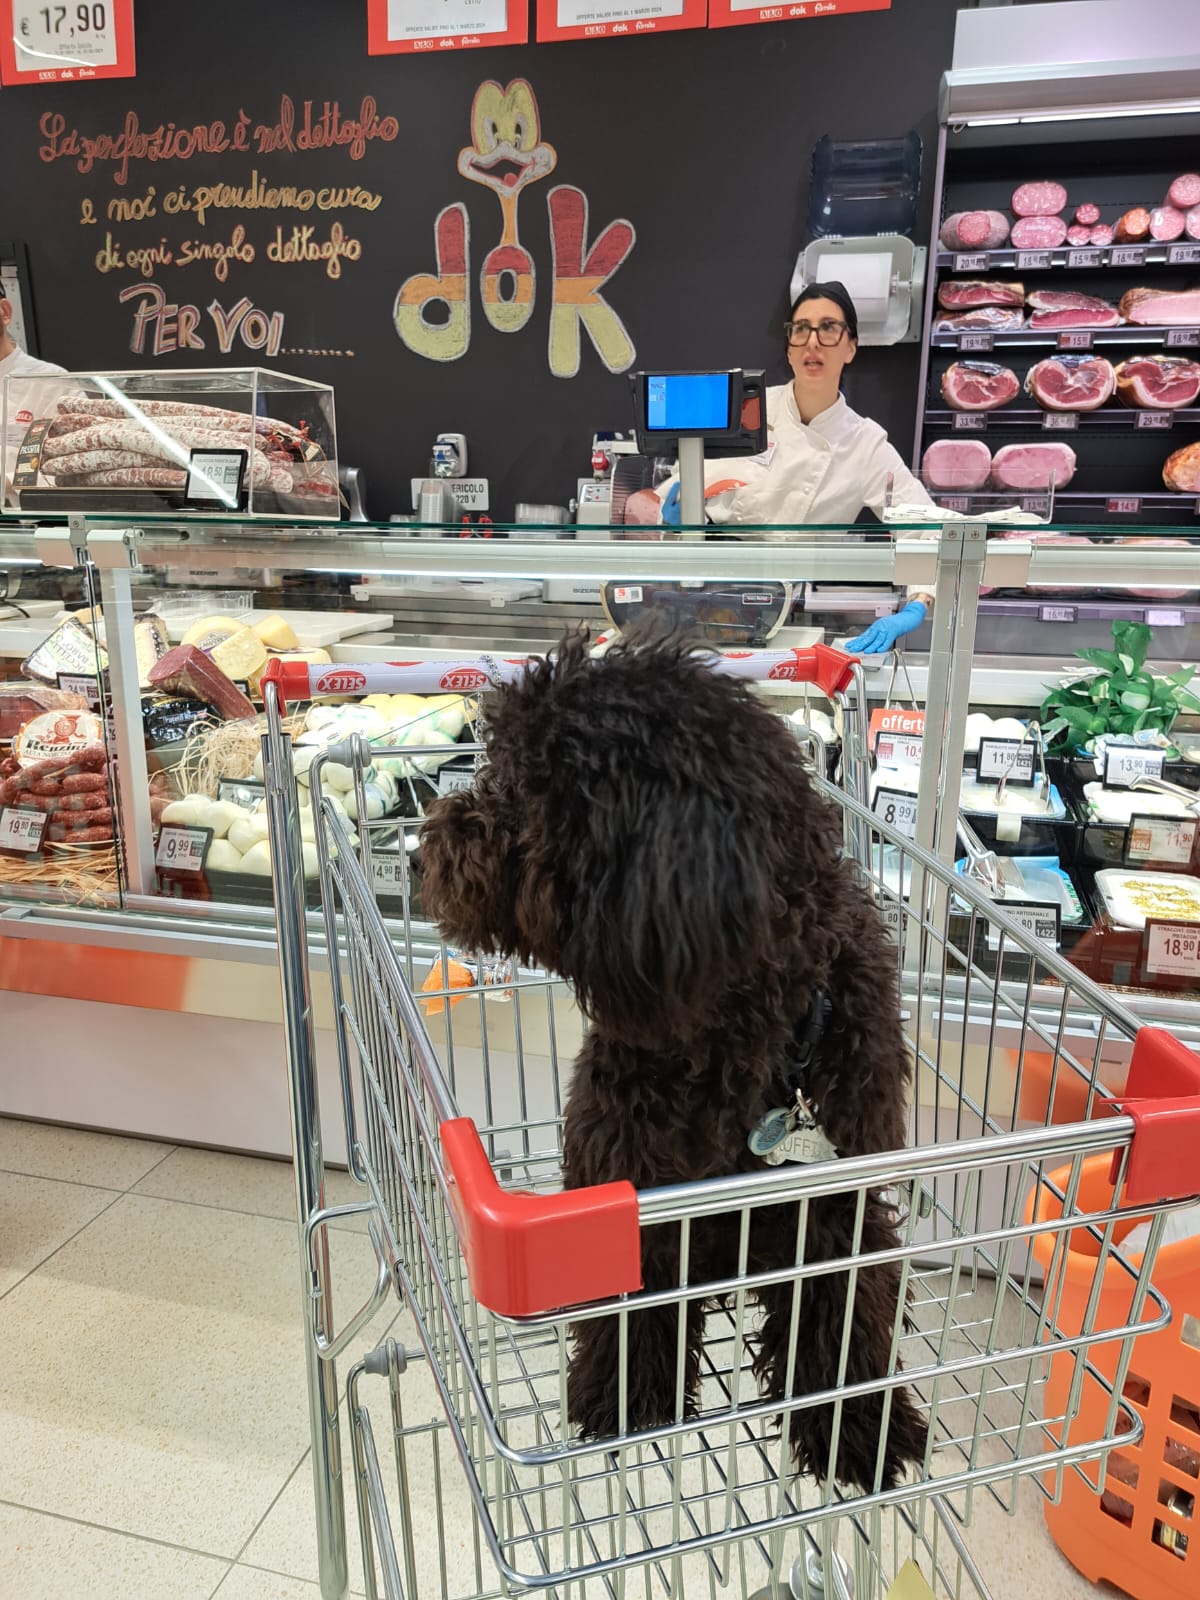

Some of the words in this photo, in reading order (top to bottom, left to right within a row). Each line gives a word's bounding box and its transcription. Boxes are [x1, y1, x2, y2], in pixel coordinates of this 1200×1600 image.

[40, 3, 106, 37] 17,90
[790, 8, 806, 16] dok
[612, 24, 628, 32] dok
[440, 39, 454, 47] dok
[40, 112, 80, 162] La
[230, 108, 252, 150] è
[253, 94, 296, 153] nel
[297, 96, 399, 160] dettaglio
[80, 199, 98, 224] e
[107, 186, 156, 222] noi
[163, 185, 192, 214] ci
[317, 186, 382, 211] cura
[95, 231, 125, 273] di
[126, 238, 173, 277] ogni
[175, 225, 256, 283] singolo
[267, 222, 361, 279] dettaglio
[394, 184, 637, 378] dok
[119, 283, 205, 356] PER
[452, 484, 484, 493] ERICOLO
[323, 677, 366, 690] SELEX
[445, 675, 487, 689] SELEX
[881, 714, 924, 731] offert
[885, 804, 911, 824] 8,99
[167, 838, 189, 859] 9,99
[1164, 938, 1195, 957] 18,90
